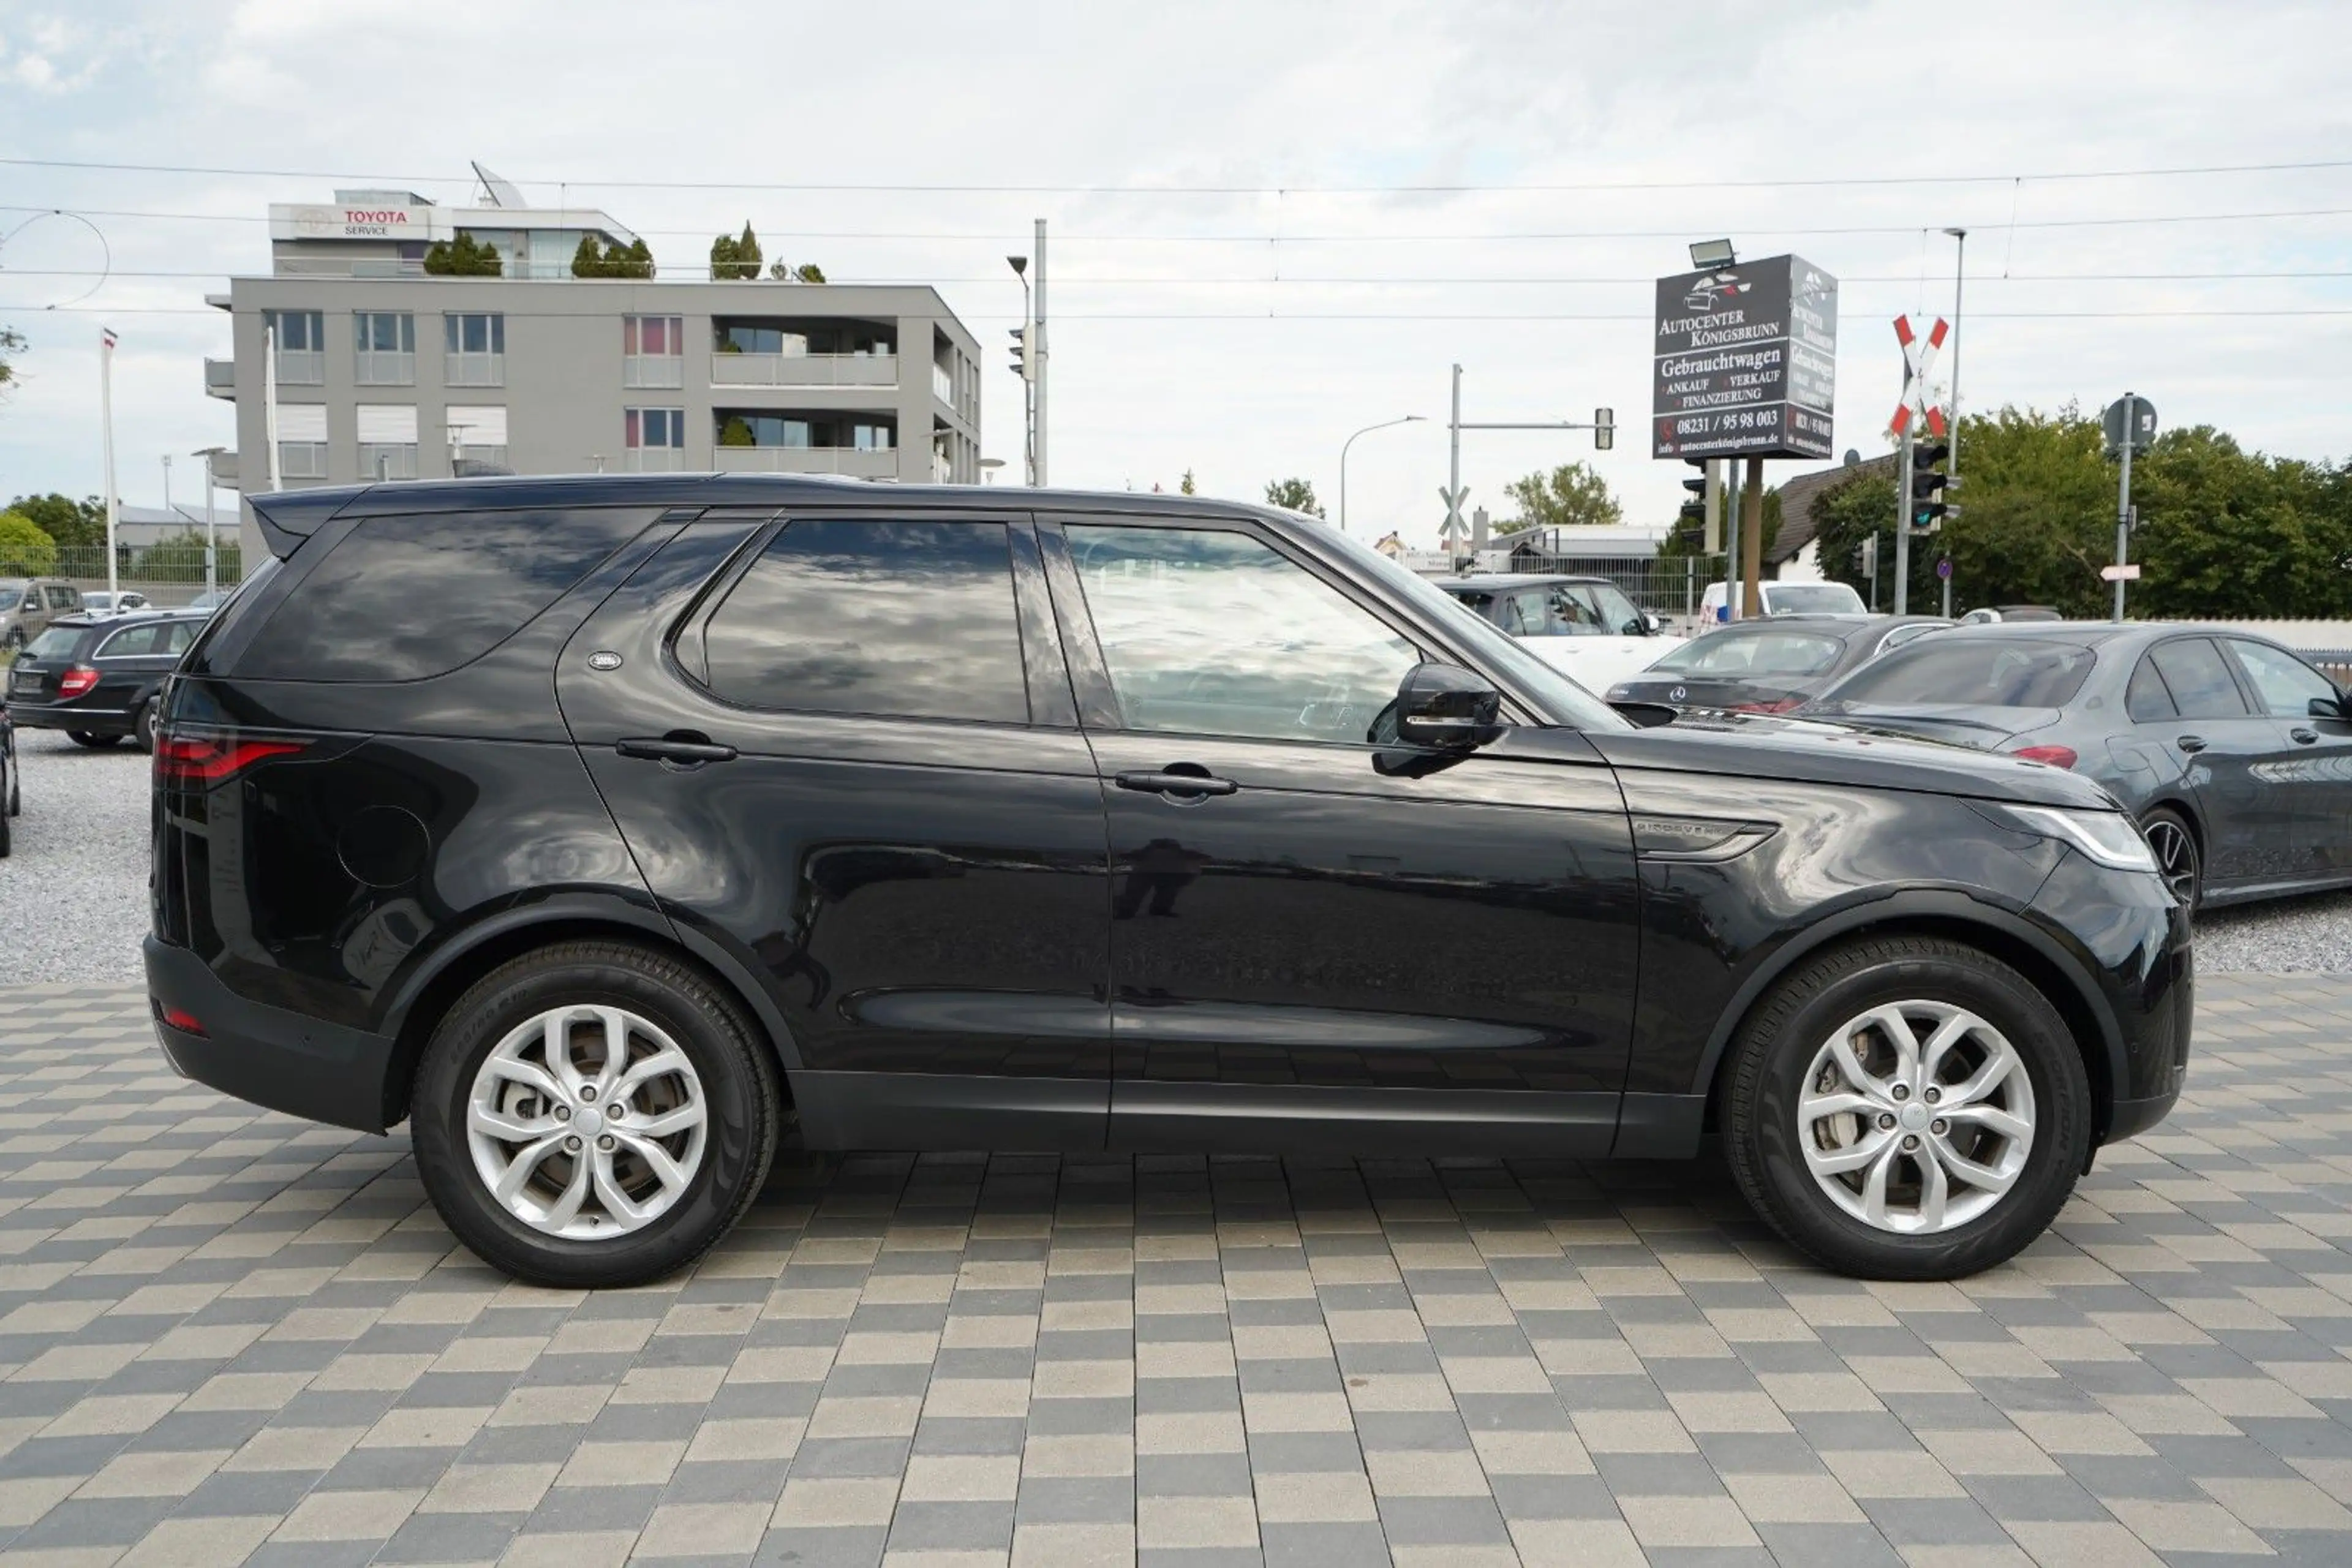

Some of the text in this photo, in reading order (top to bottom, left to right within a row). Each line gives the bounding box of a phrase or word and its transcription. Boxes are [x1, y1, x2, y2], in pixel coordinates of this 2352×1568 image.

[345, 211, 407, 223] TOYOTA
[345, 225, 388, 235] SERVICE
[1659, 309, 1744, 336] AUTOCENTER
[1662, 349, 1781, 377] Gebrauchtwagen
[1667, 379, 1710, 395] ANKAUF
[1730, 370, 1781, 387] VERKAUF
[1683, 387, 1762, 408] FINANZIERUNG
[1677, 417, 1709, 434] 08231
[1723, 414, 1737, 429] 95
[1740, 412, 1754, 428] 98
[1756, 410, 1777, 427] 003
